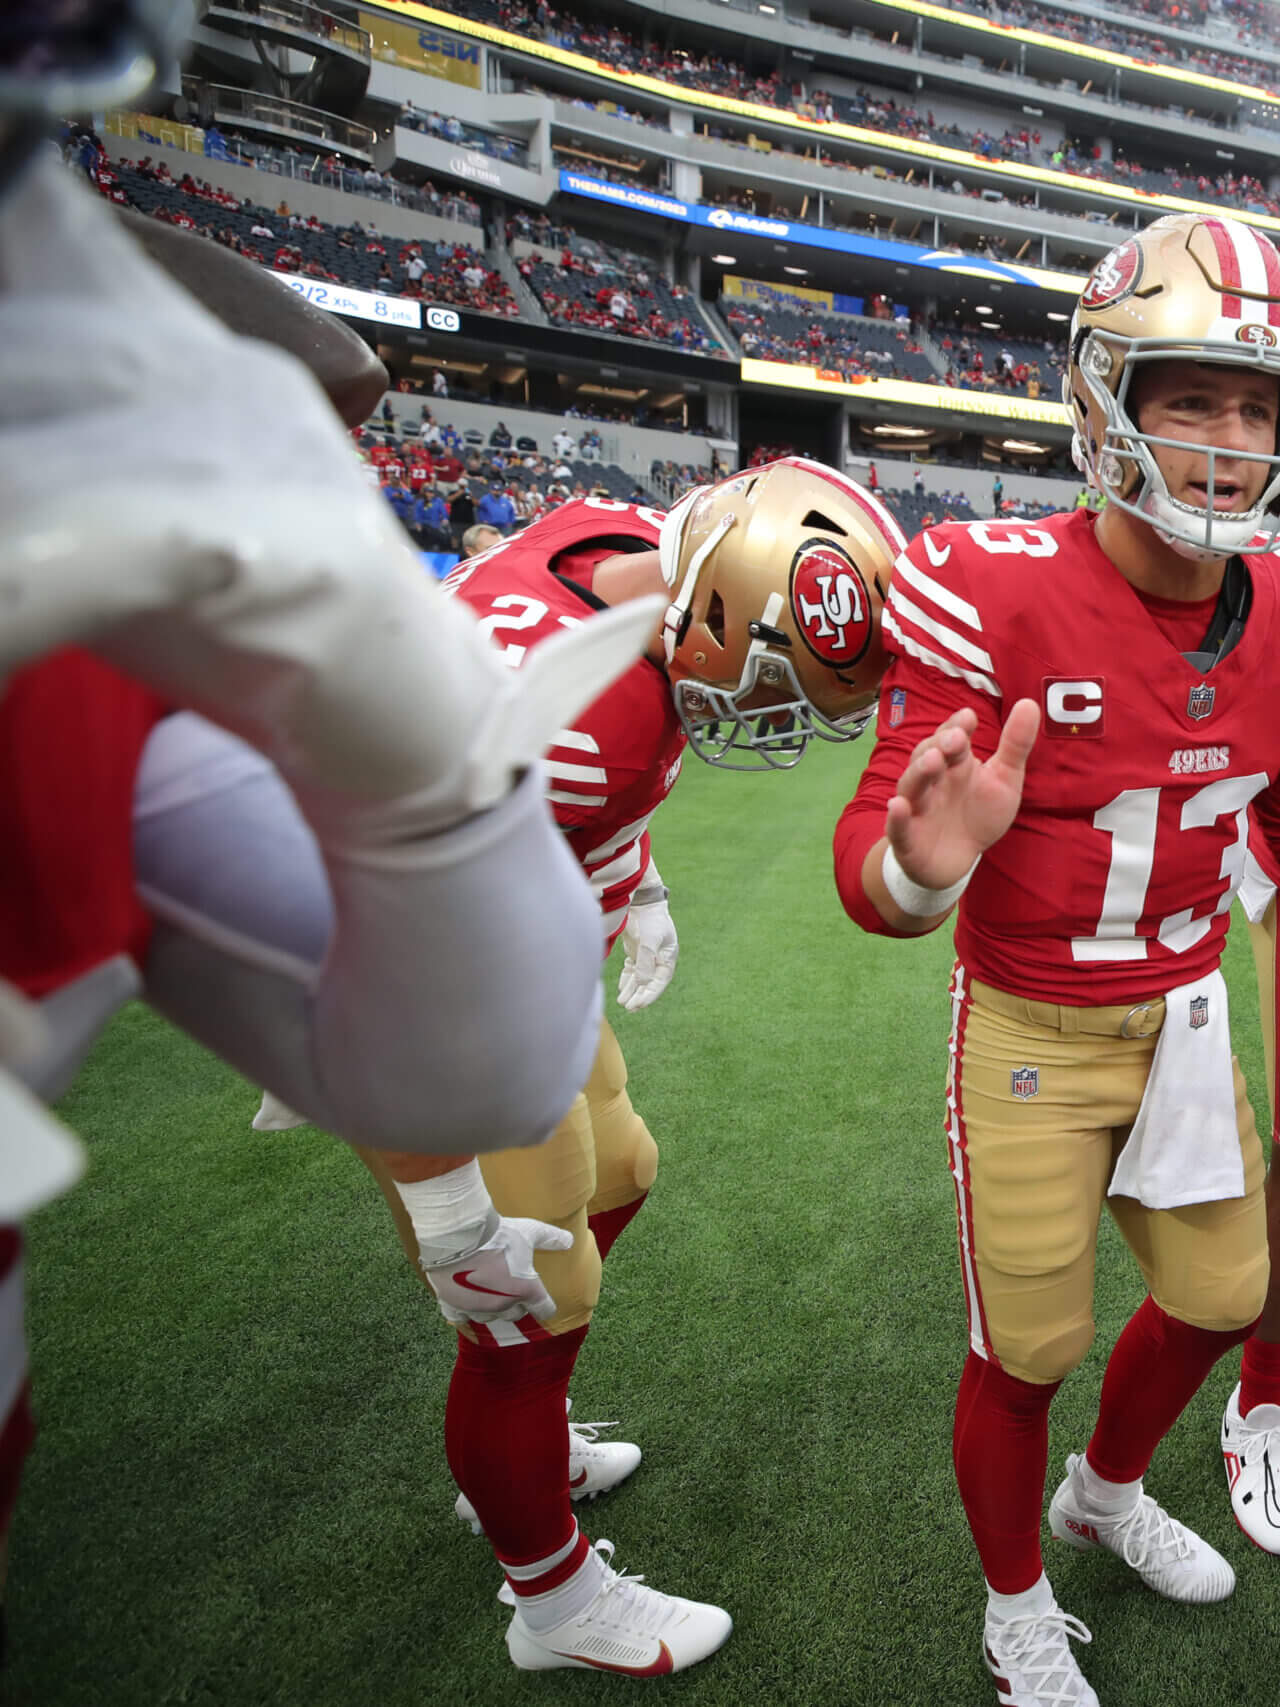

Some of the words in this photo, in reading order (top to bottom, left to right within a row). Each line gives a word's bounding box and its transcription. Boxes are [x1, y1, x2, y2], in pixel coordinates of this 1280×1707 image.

[374, 300, 388, 317] 8
[430, 311, 456, 329] CC
[1046, 682, 1102, 724] C
[1168, 746, 1230, 775] 49ERS
[1071, 772, 1270, 961] 13
